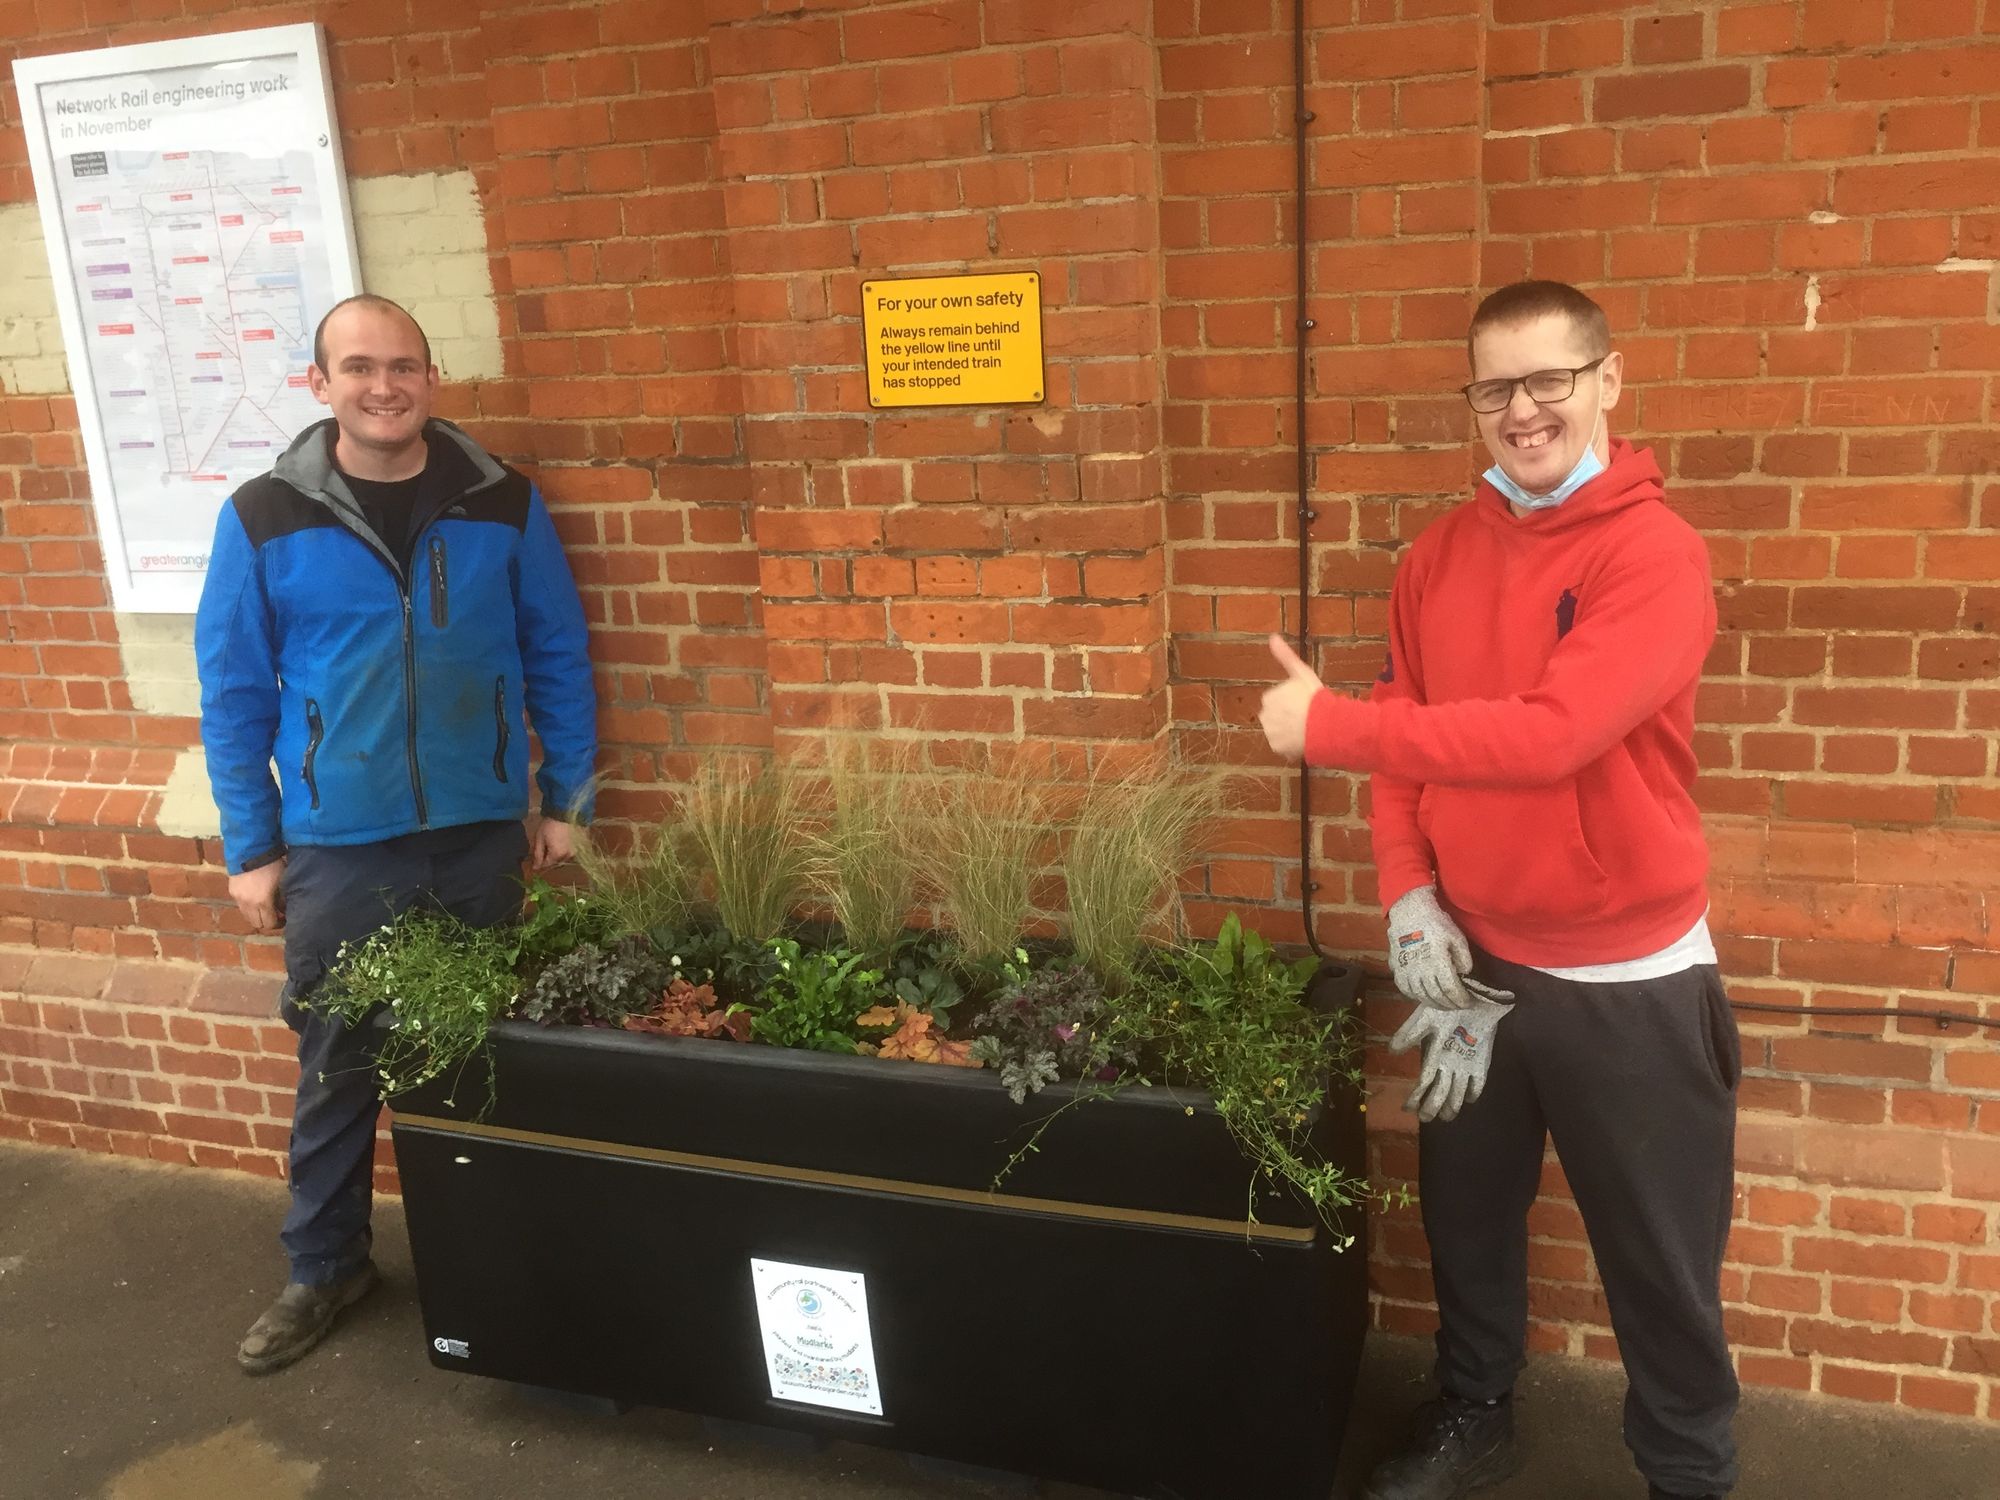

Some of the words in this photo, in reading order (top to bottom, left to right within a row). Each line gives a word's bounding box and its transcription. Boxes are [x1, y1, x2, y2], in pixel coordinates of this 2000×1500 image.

[56, 94, 117, 116] Network
[120, 88, 149, 107] Rail
[152, 81, 246, 106] engineering
[250, 74, 289, 93] work
[60, 122, 74, 139] in
[77, 116, 153, 138] November
[877, 297, 902, 311] For
[904, 297, 938, 313] your
[940, 295, 973, 309] own
[975, 290, 1024, 307] safety
[880, 326, 926, 340] Always
[928, 323, 973, 337] remain
[975, 320, 1020, 335] behind
[881, 343, 902, 355] the
[904, 341, 945, 356] yellow
[948, 340, 970, 353] line
[973, 338, 1001, 351] until
[882, 361, 911, 374] your
[913, 356, 969, 371] intended
[972, 355, 1001, 369] train
[883, 376, 906, 389] has
[908, 374, 961, 389] stopped
[1814, 387, 1951, 423] FINN
